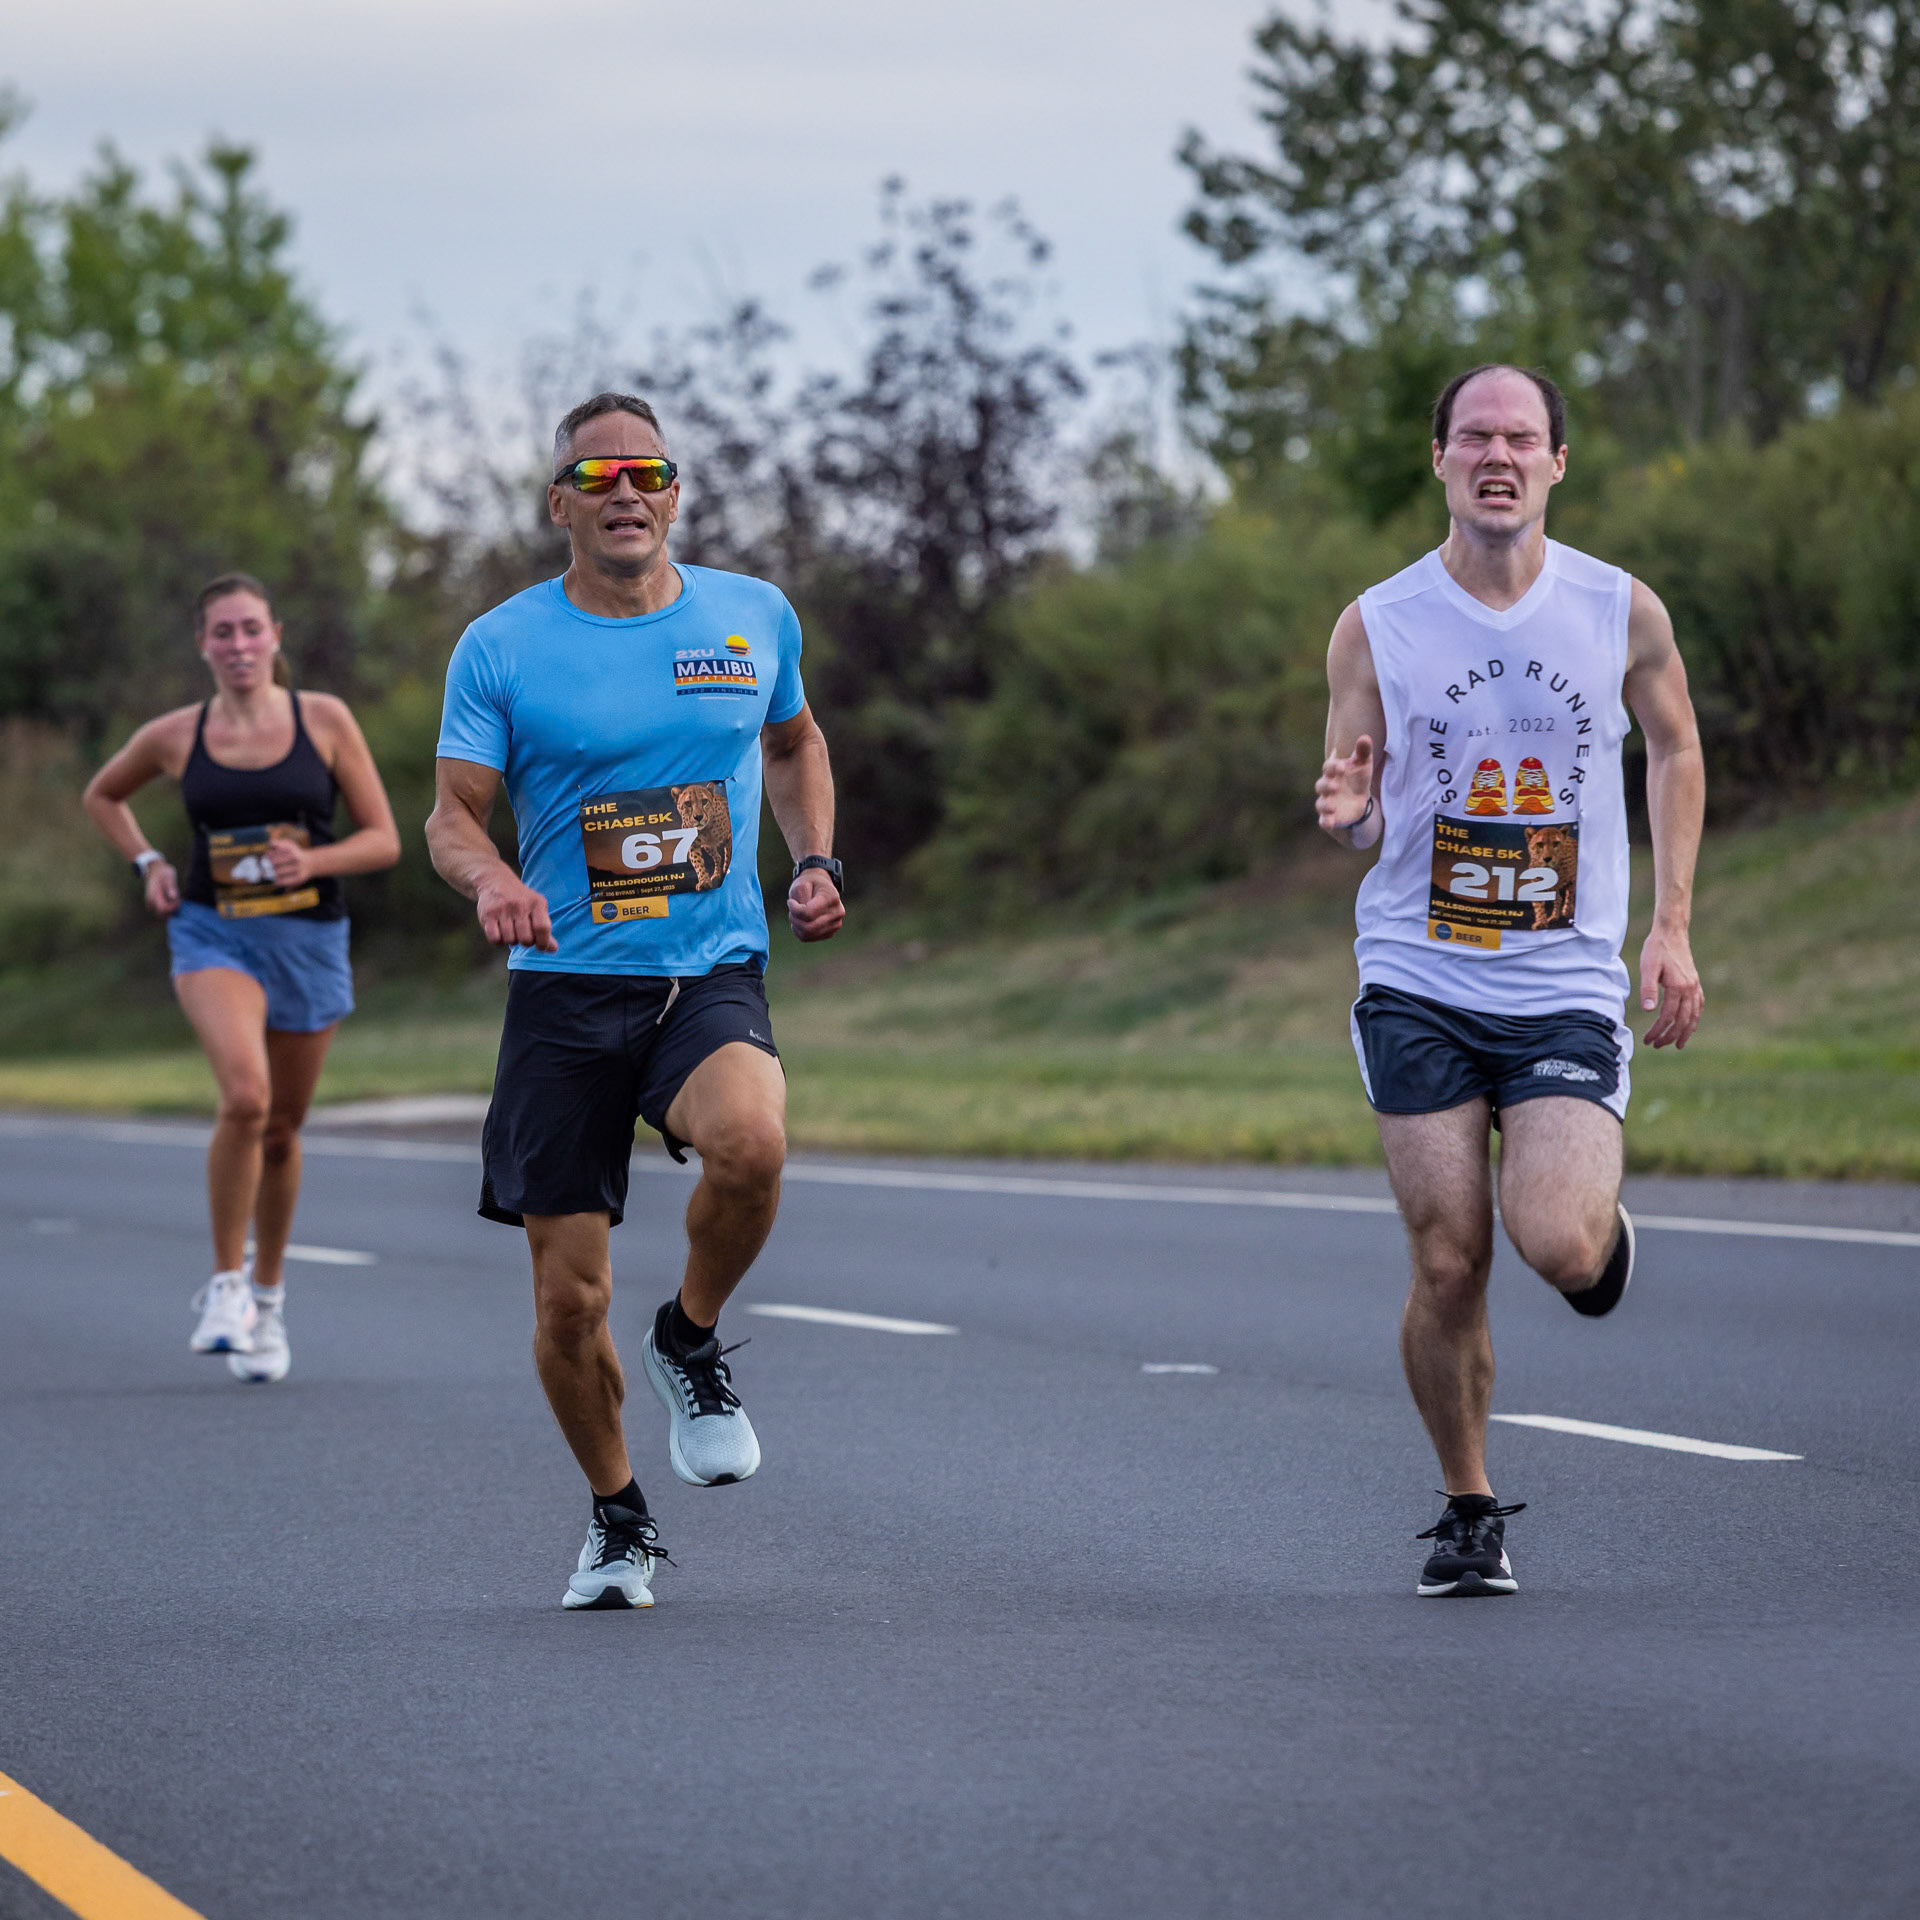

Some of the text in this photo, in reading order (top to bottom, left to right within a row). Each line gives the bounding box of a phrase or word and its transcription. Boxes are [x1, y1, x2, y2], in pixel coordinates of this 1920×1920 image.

[675, 648, 715, 659] 2XU
[676, 660, 754, 677] MALIBU
[680, 675, 753, 683] TRIATHLON
[1429, 659, 1593, 806] SOME RAD RUNNERS
[1509, 717, 1555, 733] 2022
[583, 802, 617, 816] THE
[584, 811, 673, 832] CHASE 5K
[1436, 823, 1469, 839] THE
[621, 827, 699, 869] 67
[1435, 840, 1523, 860] CHASE 5K
[670, 872, 685, 880] NJ
[1450, 862, 1559, 901] 212
[622, 905, 650, 916] BEER
[1455, 932, 1482, 944] BEER
